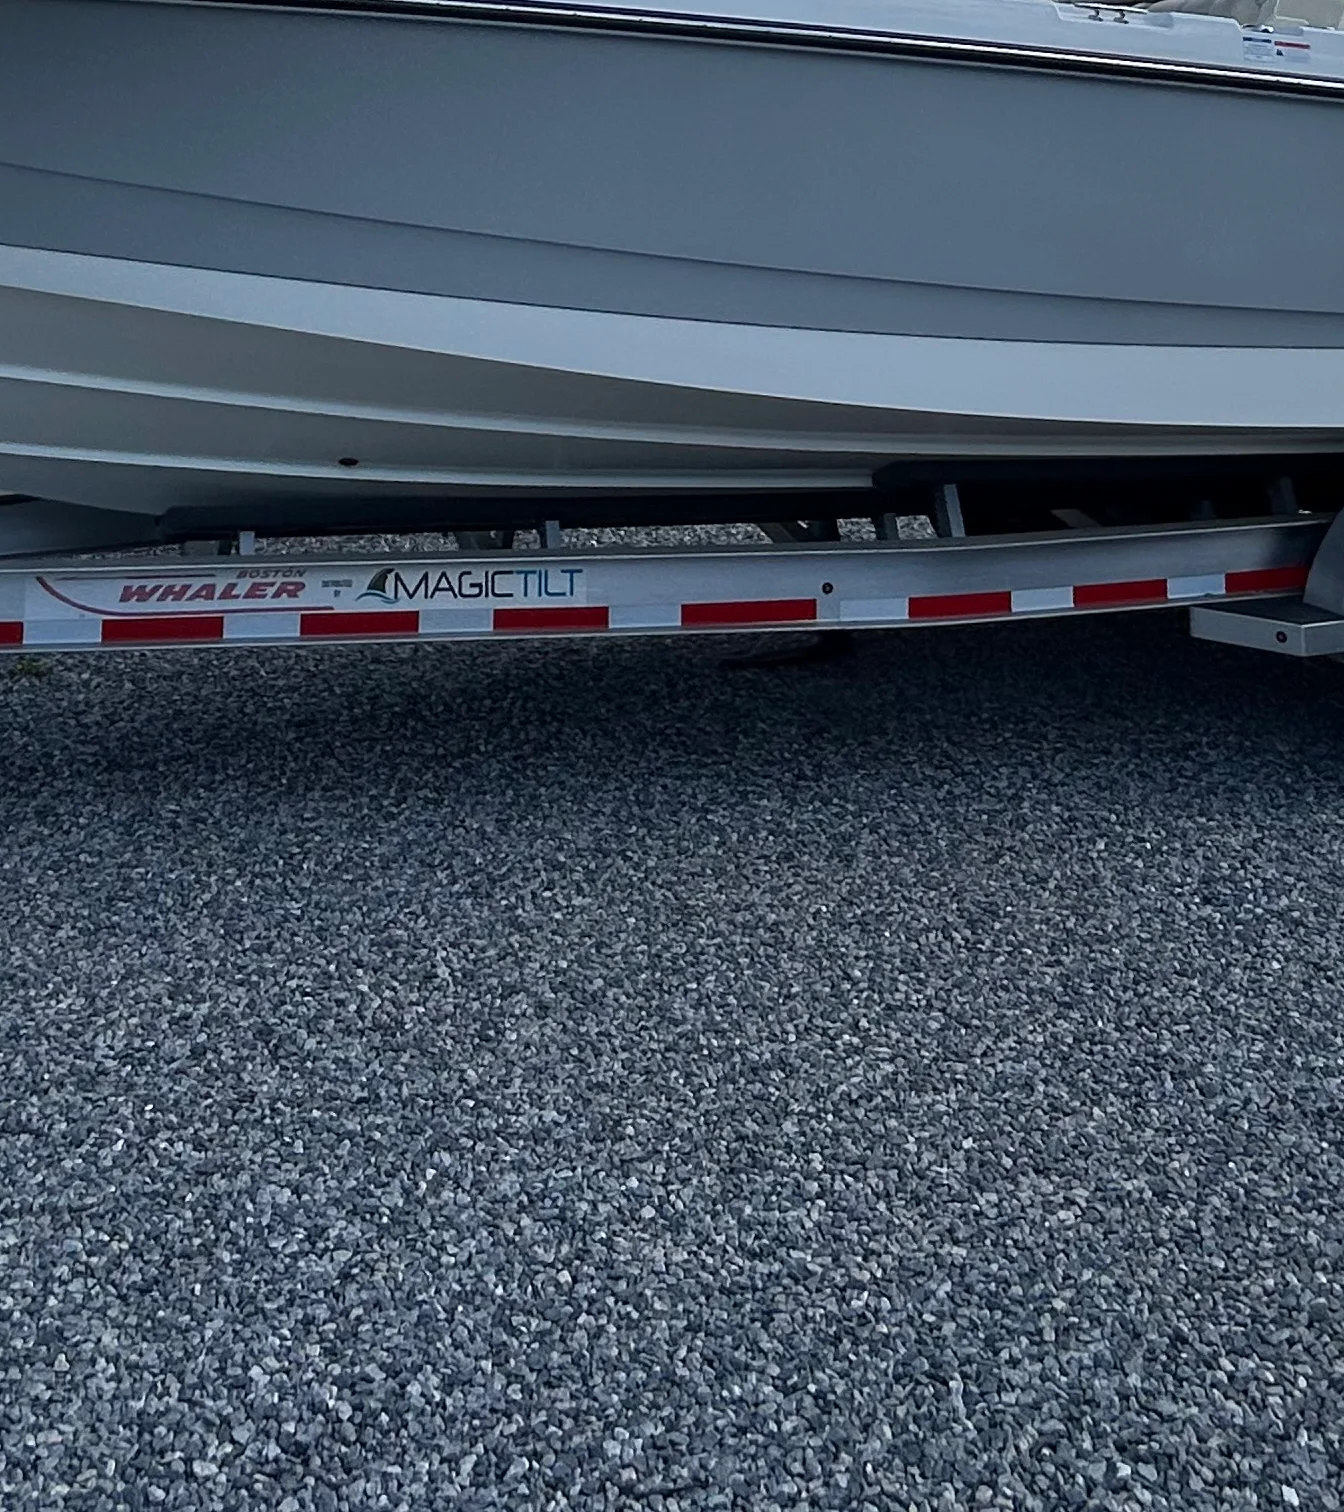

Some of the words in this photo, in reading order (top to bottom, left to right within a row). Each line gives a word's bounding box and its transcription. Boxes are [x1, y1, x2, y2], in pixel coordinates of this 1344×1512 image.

[235, 568, 306, 580] BOSTON
[393, 568, 584, 600] MAGICTILT
[118, 580, 306, 604] WHALER
